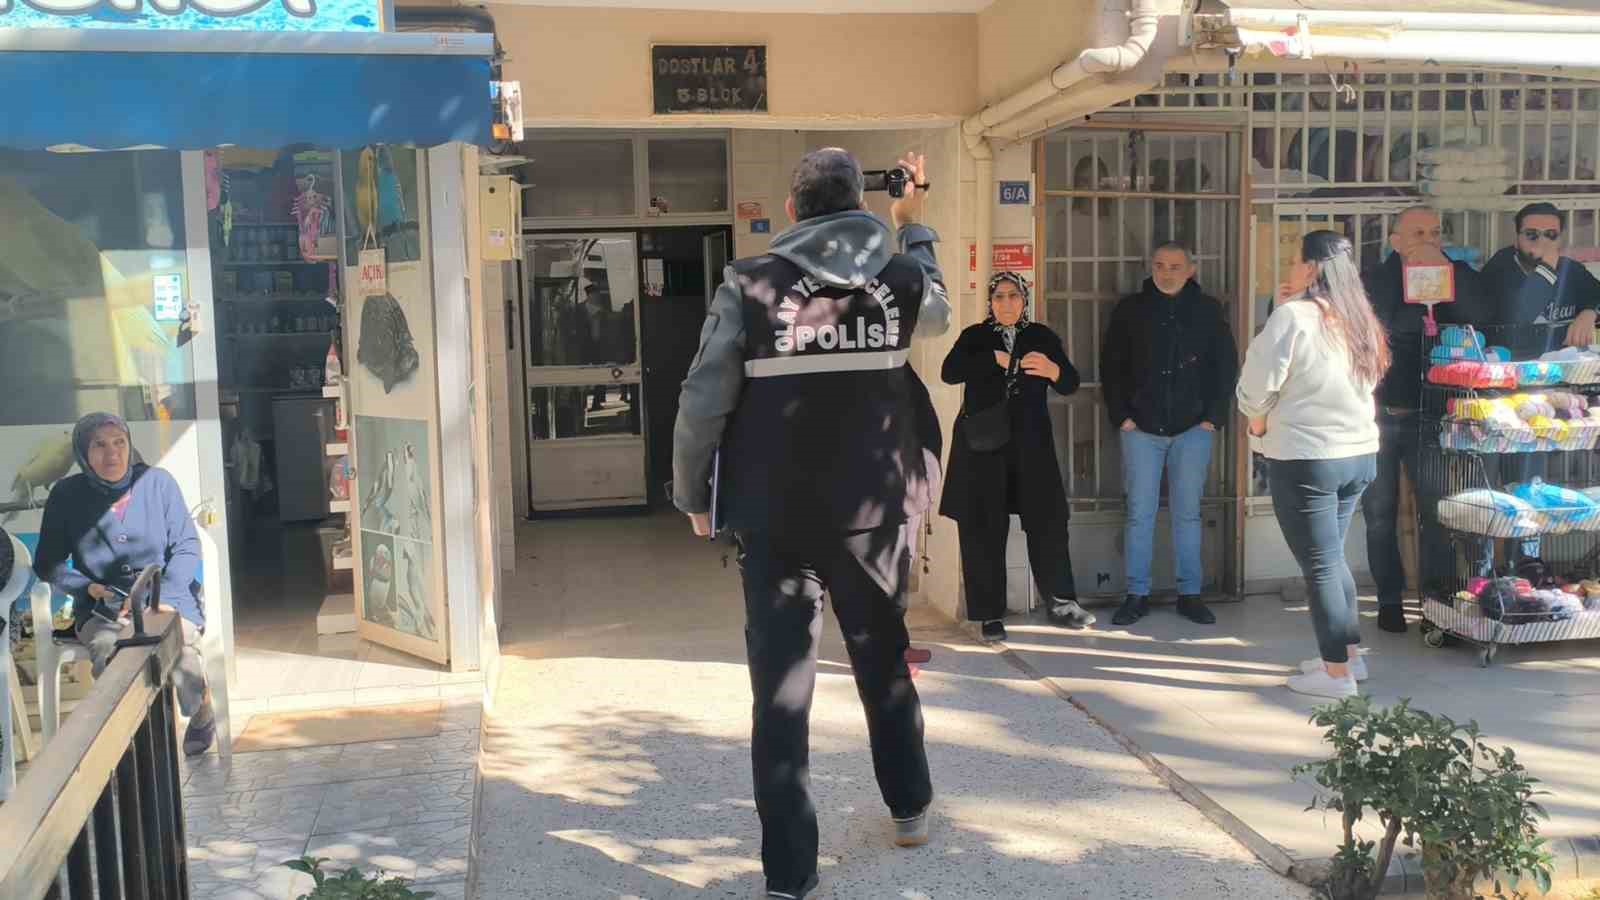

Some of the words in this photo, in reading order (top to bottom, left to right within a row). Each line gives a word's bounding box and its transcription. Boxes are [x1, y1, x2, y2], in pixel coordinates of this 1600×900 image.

[657, 56, 736, 75] DOSTLAR
[743, 48, 759, 75] 4
[1003, 187, 1027, 201] 6/A
[361, 263, 384, 282] AÇIK
[774, 295, 800, 352] OLAY
